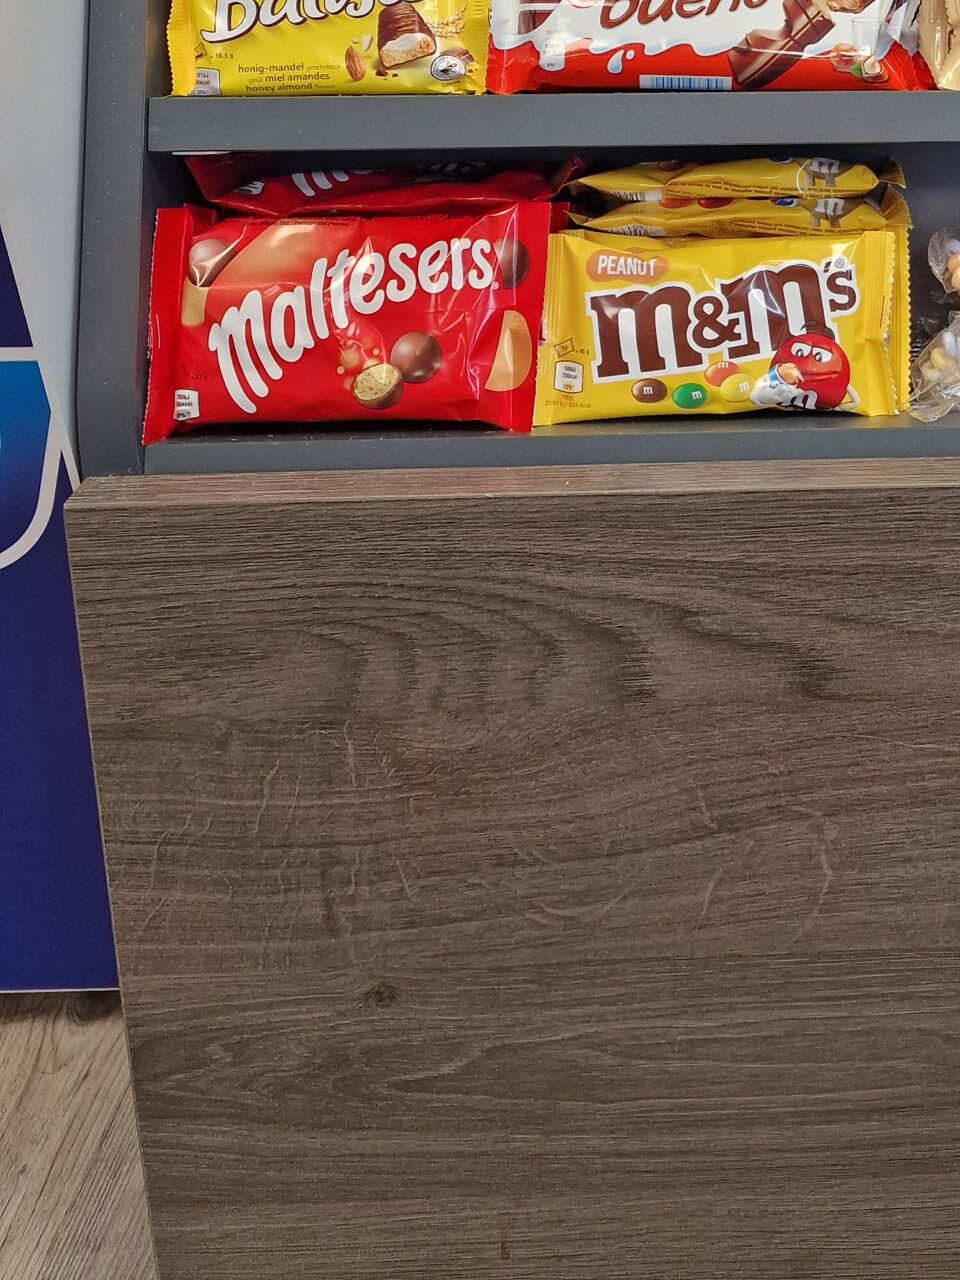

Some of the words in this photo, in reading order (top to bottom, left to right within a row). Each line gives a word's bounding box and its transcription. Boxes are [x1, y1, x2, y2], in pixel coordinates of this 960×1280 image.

[238, 62, 304, 74] honig-mandel
[249, 76, 263, 84] goût
[265, 73, 285, 82] miel
[287, 73, 330, 82] amandes
[246, 84, 275, 92] honey
[278, 82, 313, 91] almond
[596, 255, 657, 277] PEANUT
